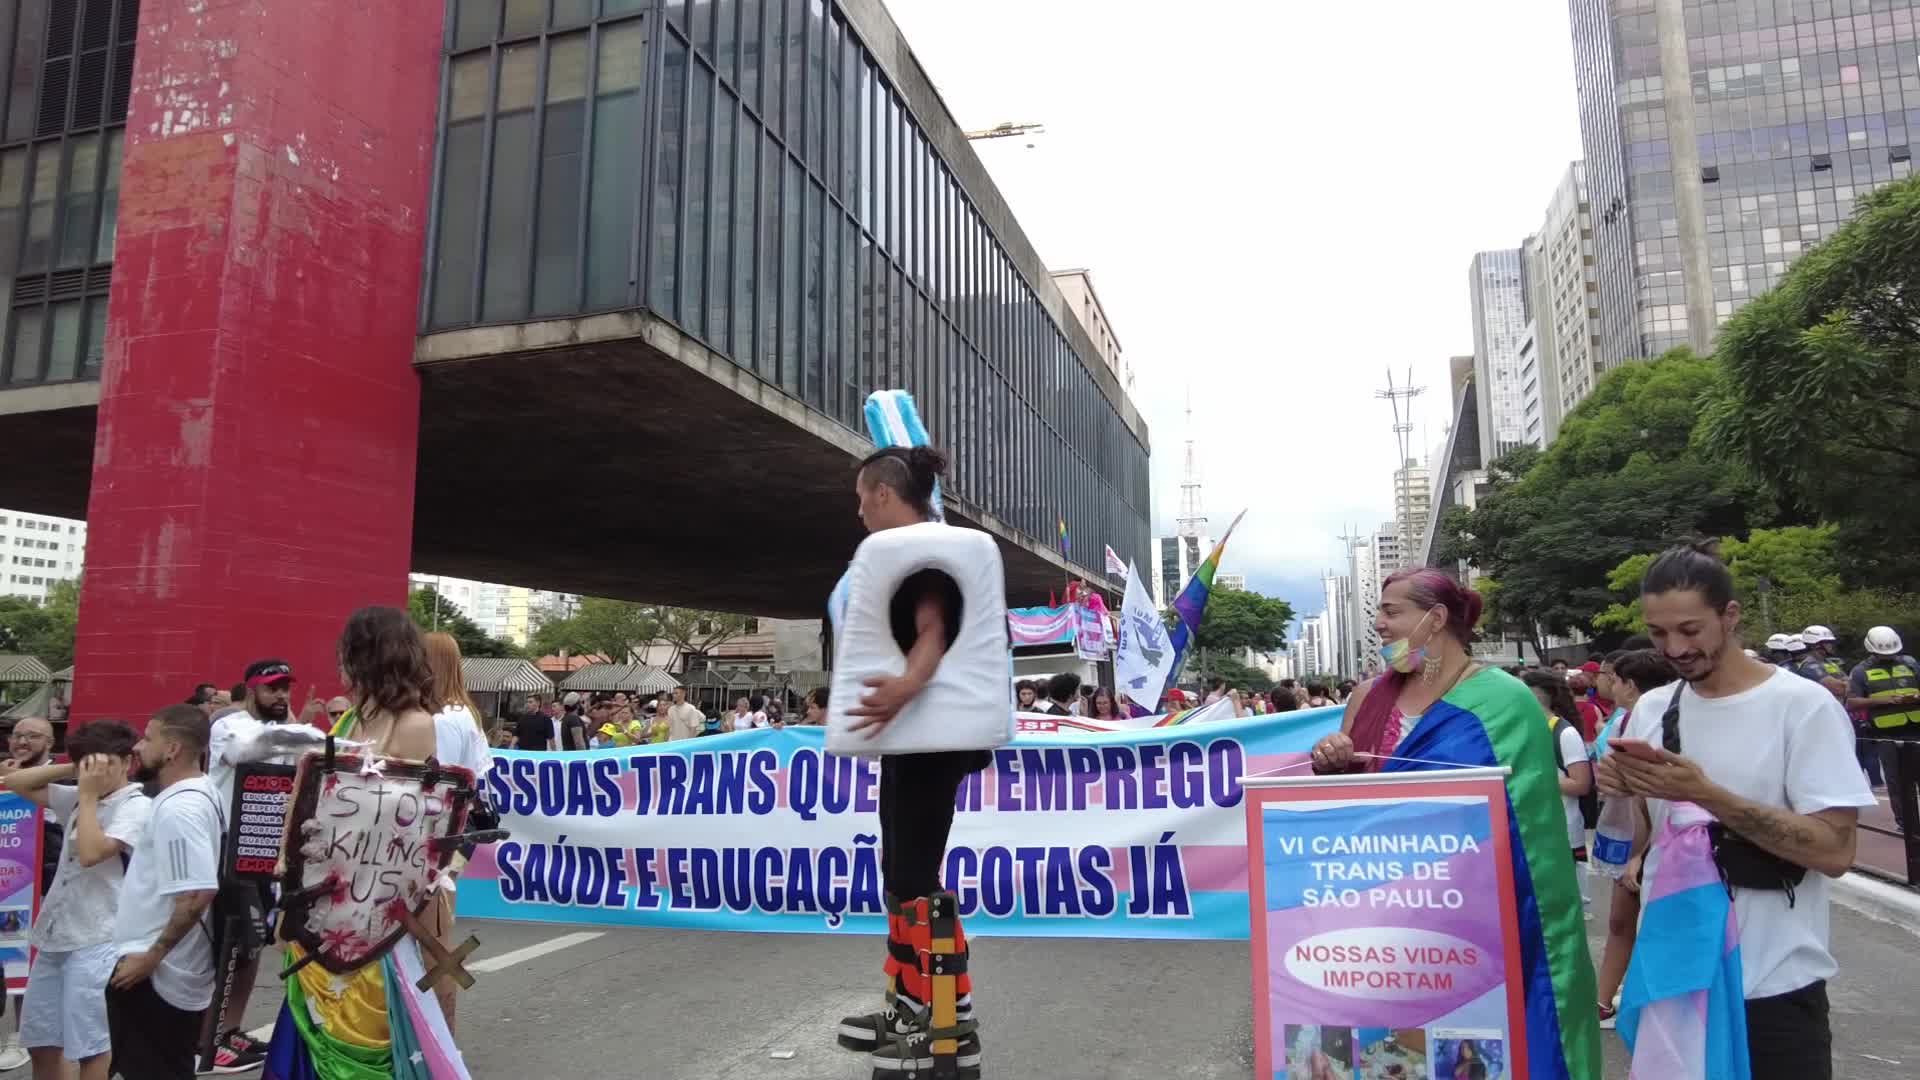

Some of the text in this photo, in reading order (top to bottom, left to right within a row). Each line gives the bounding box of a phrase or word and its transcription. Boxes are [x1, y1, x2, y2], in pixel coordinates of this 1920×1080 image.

[477, 757, 622, 816] SSOAS
[631, 751, 777, 816] TRANS
[995, 739, 1244, 813] EMPREGO
[330, 785, 443, 834] STOP
[240, 825, 284, 836] OPORTUN
[1279, 834, 1481, 856] VI CAMINHADA
[497, 831, 1190, 927] SAÚDE E EDUCAÇÃ COTAS JÁ
[1311, 861, 1451, 881] TRANS DE
[351, 871, 403, 906] US
[1303, 884, 1464, 909] SÃO PAULO
[1295, 945, 1478, 966] NOSSAS VIDAS
[1323, 970, 1453, 990] IMPORTAM
